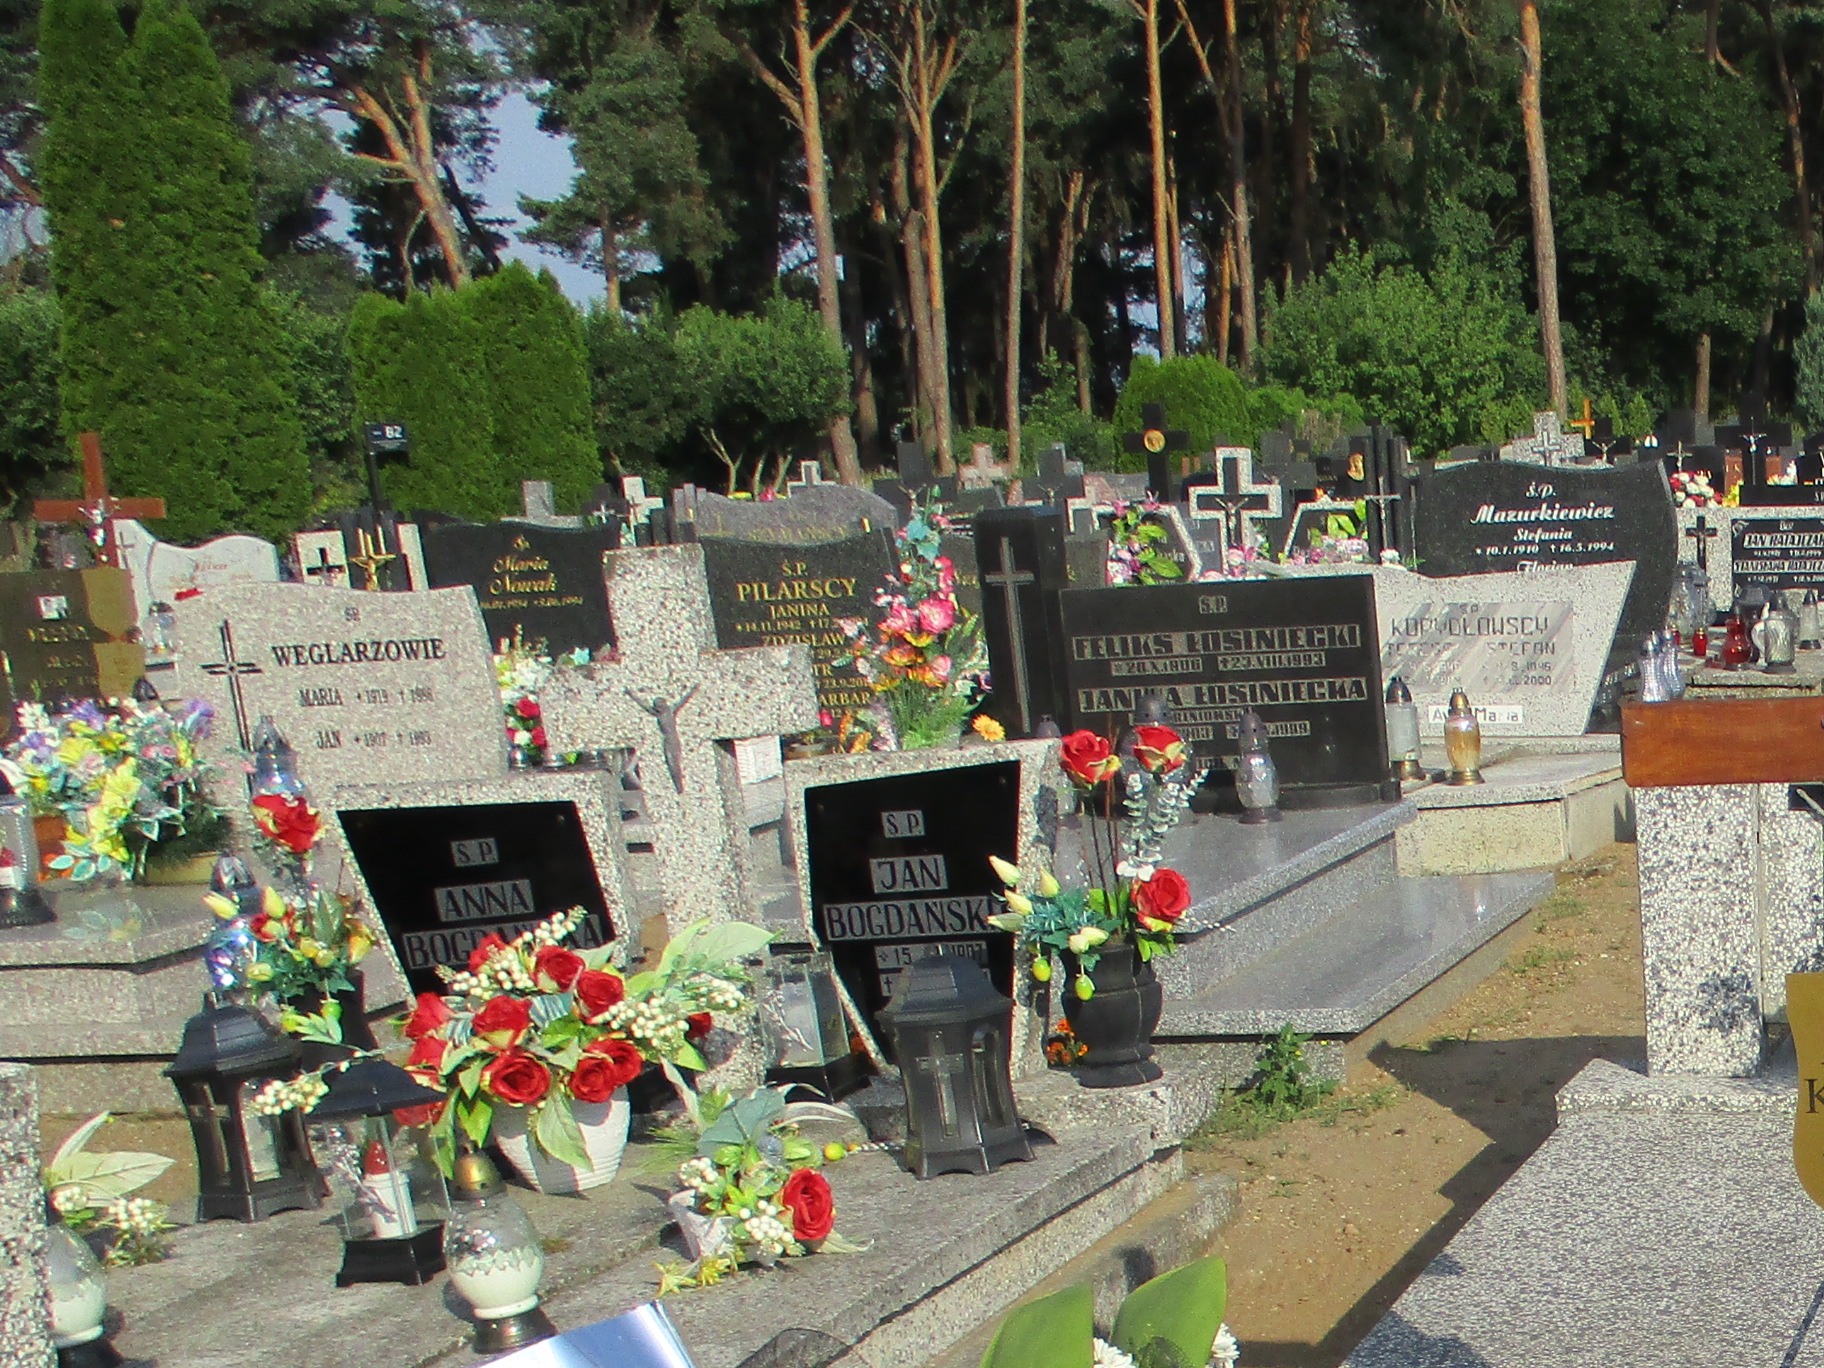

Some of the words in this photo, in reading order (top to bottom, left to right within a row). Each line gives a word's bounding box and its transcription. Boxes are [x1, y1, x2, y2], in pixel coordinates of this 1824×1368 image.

[1470, 501, 1616, 525] Mazurkiewicz
[1513, 527, 1574, 544] Stefania
[490, 572, 559, 596] Nowak
[736, 578, 857, 602] PILARSCY
[769, 603, 831, 620] JANINA
[1074, 634, 1172, 659] FELIKS
[299, 688, 343, 707] MARIA
[317, 731, 342, 749] JAN
[878, 857, 942, 891] JAN
[445, 882, 530, 919] ANNA
